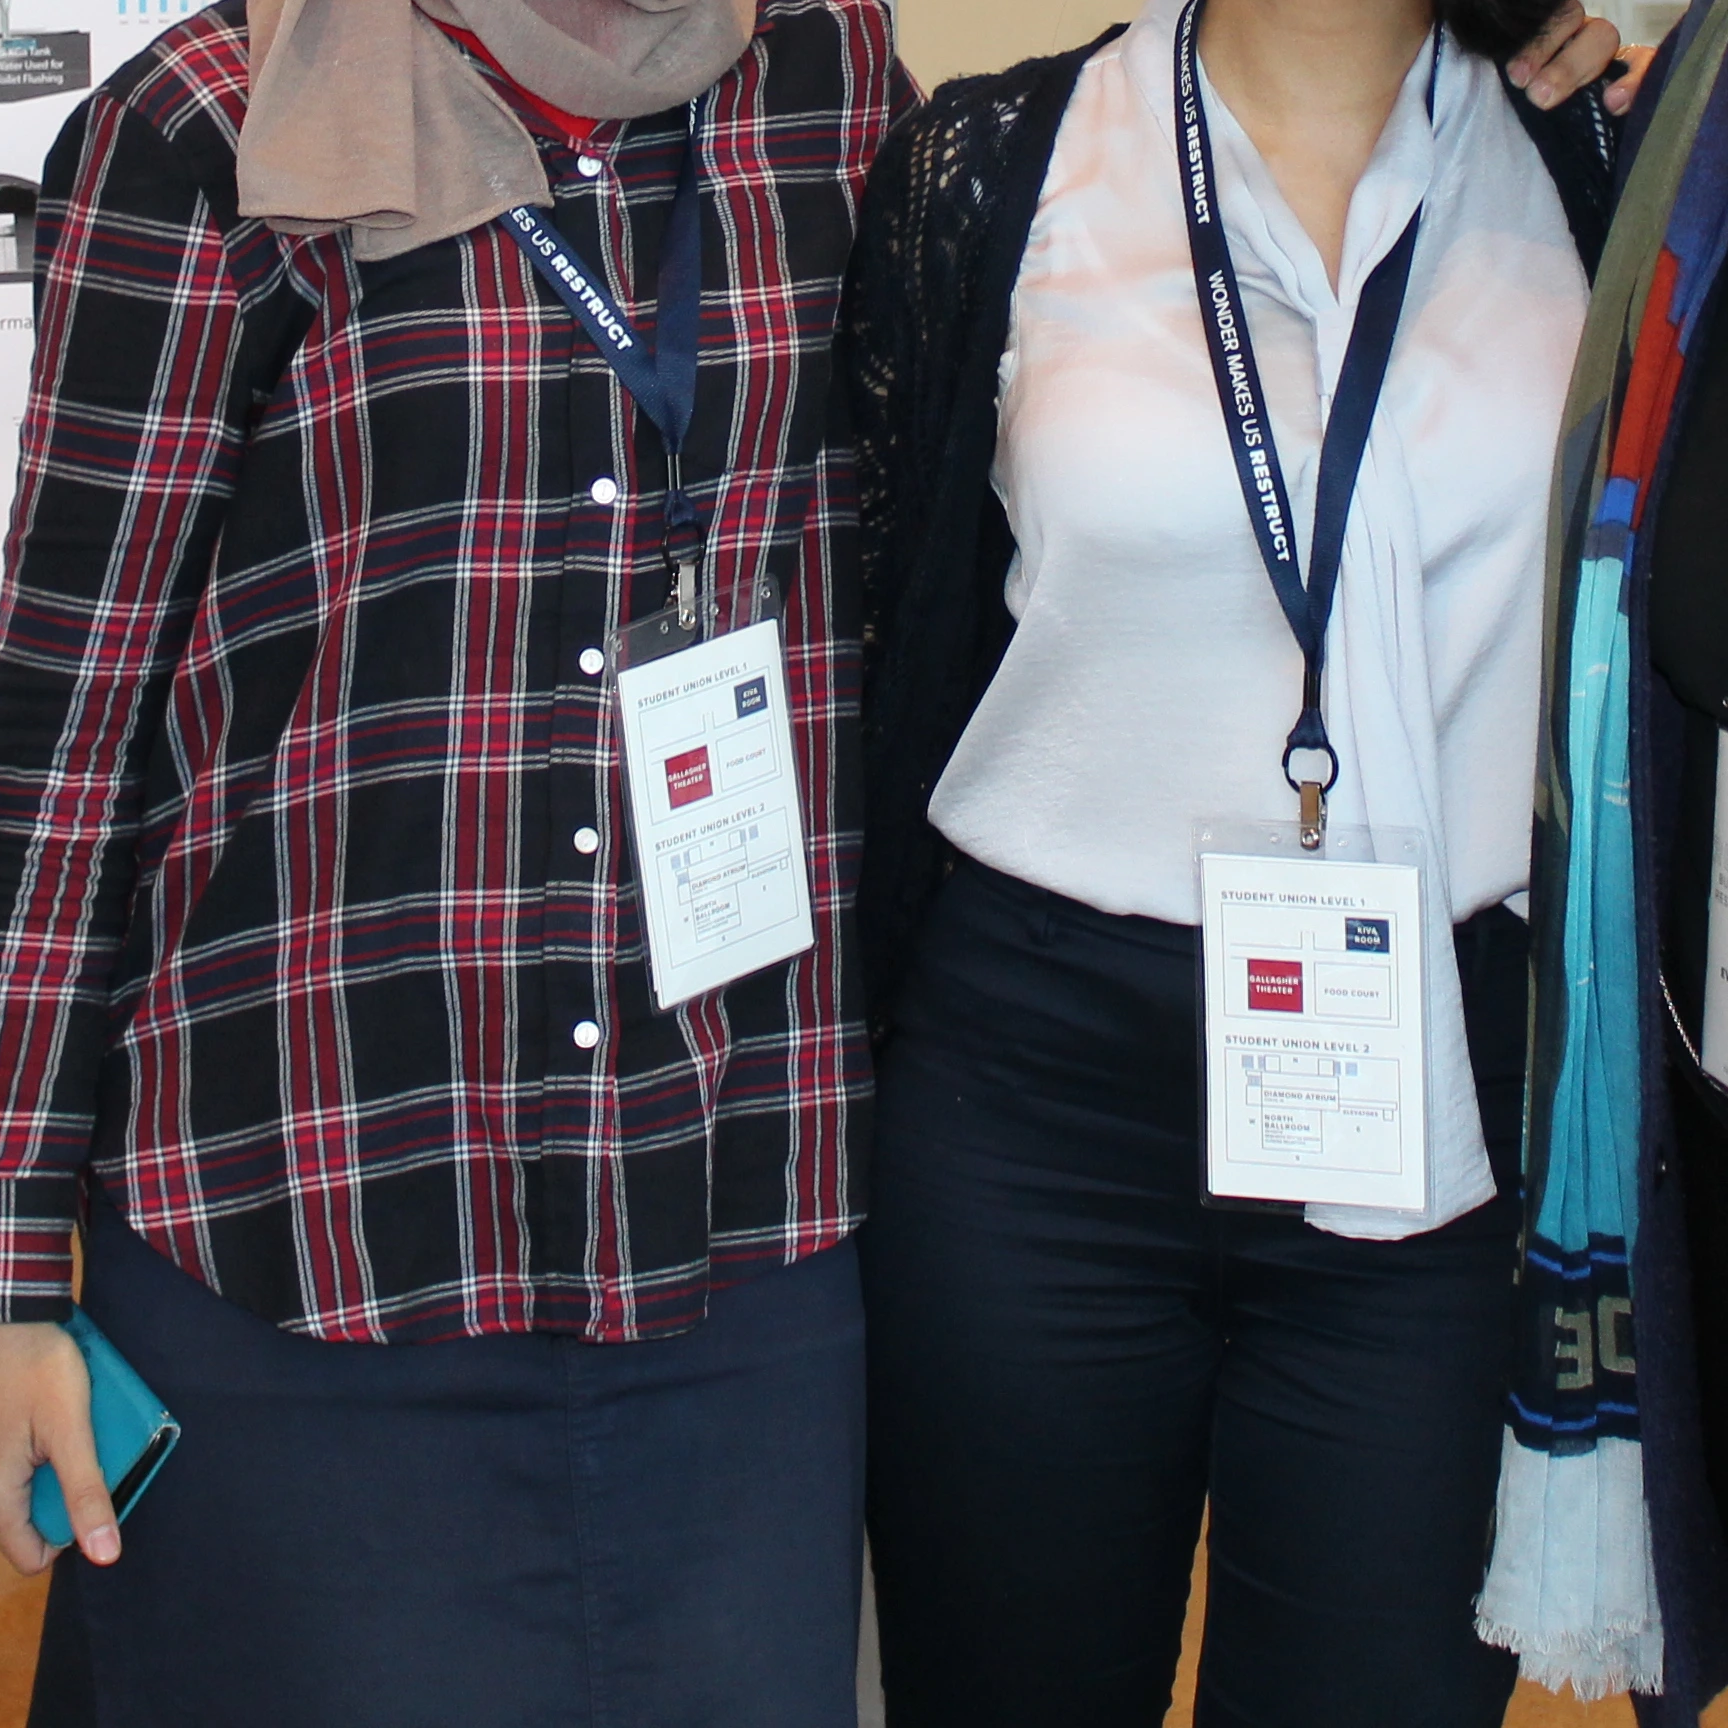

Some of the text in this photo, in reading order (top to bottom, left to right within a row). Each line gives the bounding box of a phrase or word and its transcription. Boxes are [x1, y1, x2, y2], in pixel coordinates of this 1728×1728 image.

[1183, 97, 1198, 124] US
[1186, 124, 1210, 226] RESTRUCT
[531, 229, 633, 351] US RESTRUCT
[1208, 270, 1290, 563] WONDER MAKES US RESTRUCT
[638, 661, 748, 709] STUDENT UNION LEVEL 1
[655, 802, 766, 852] STUDENT UNION LEVEL 2
[1221, 890, 1366, 907] STUDENT UNION LEVEL 1
[1354, 935, 1381, 945] ROOM
[1249, 974, 1299, 986] GALLAGHER
[1255, 984, 1293, 995] THEATER
[1324, 988, 1380, 999] FOOD COURT
[1225, 1035, 1370, 1053] STUDENT UNION LEVEL 2
[1263, 1090, 1337, 1103] DIAMOND ATRIUM
[1264, 1114, 1294, 1123] NORTH
[1264, 1121, 1310, 1132] BALLROOM
